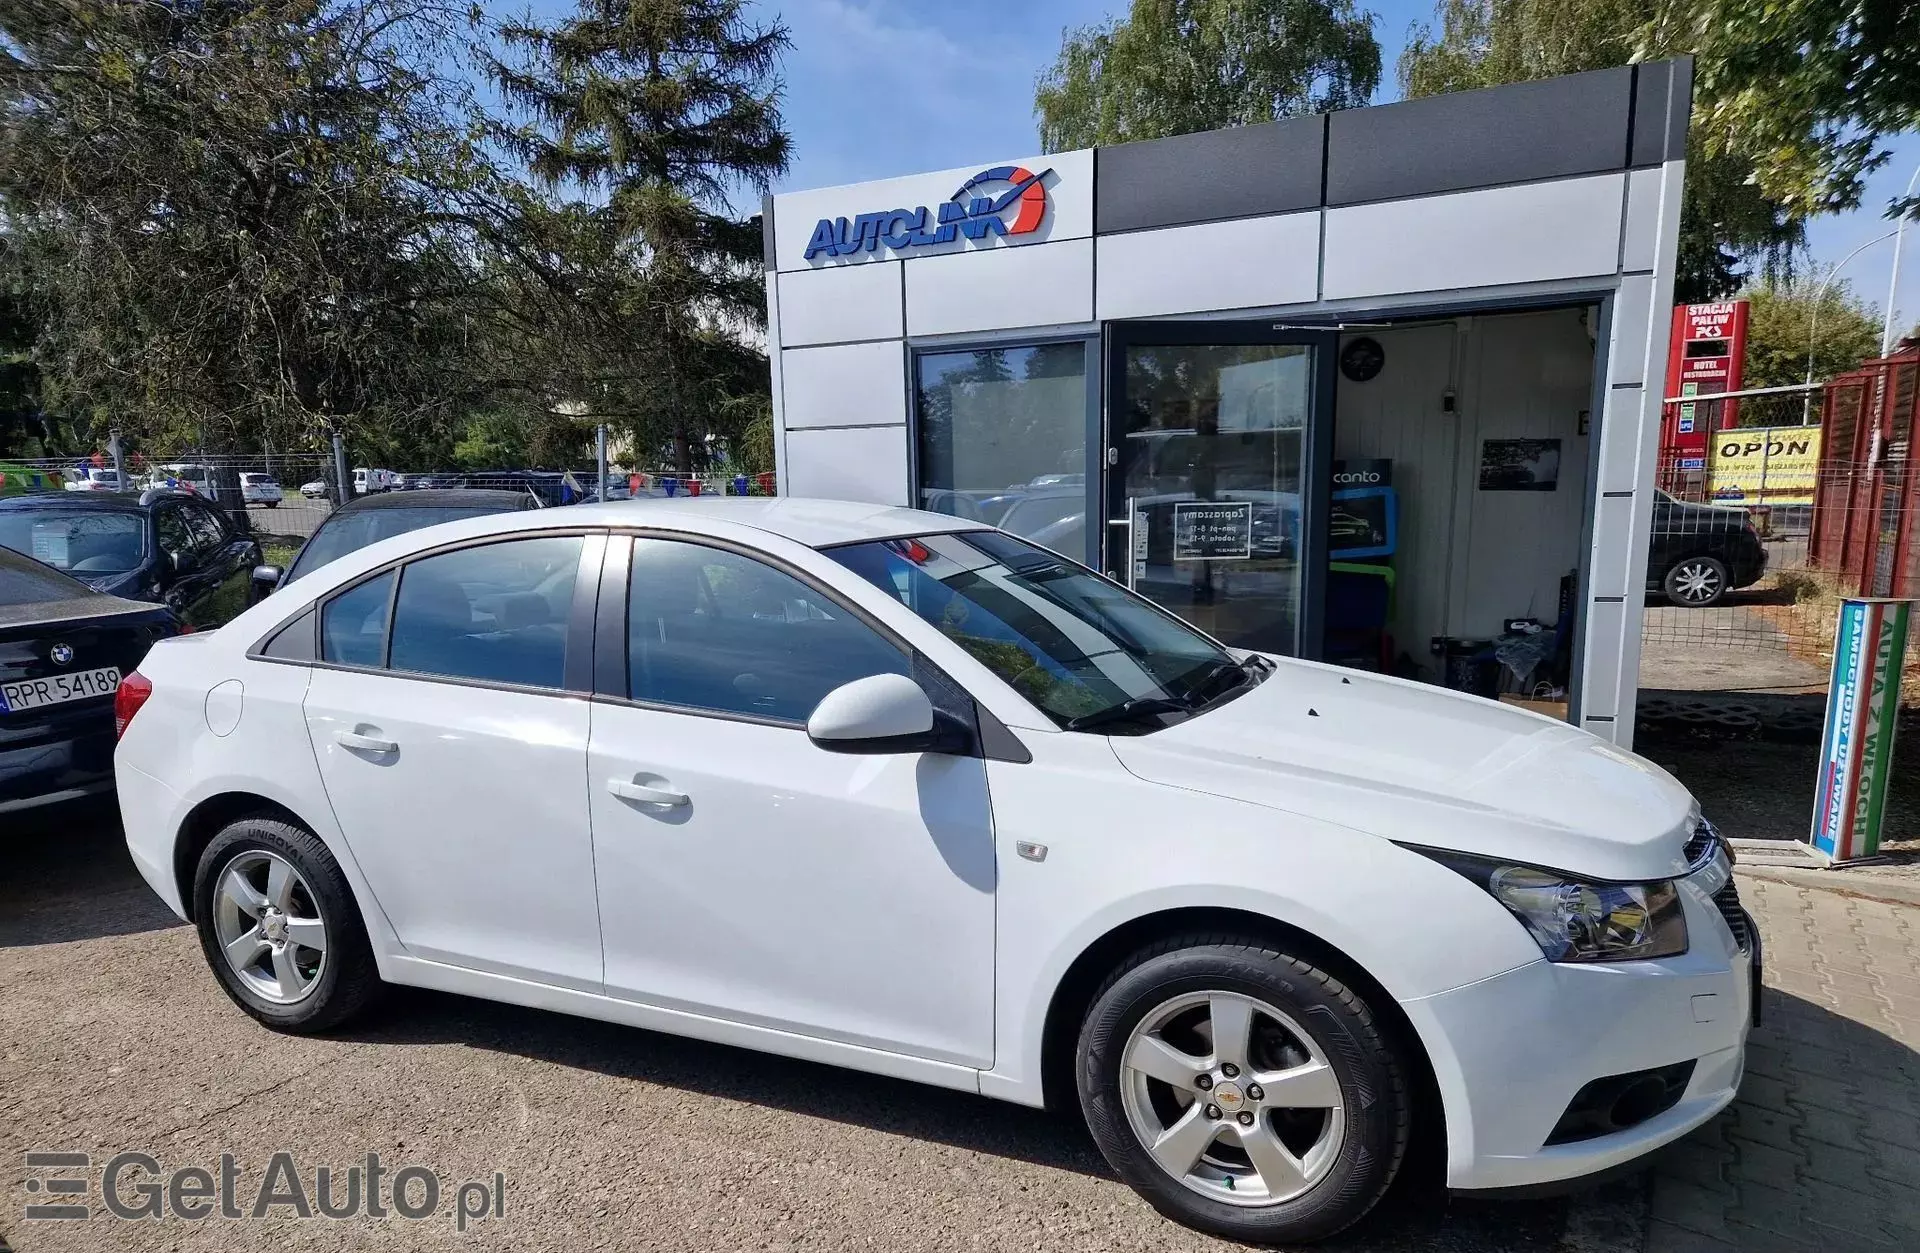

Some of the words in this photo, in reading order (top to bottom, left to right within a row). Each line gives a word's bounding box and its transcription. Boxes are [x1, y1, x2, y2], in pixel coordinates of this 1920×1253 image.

[803, 196, 1010, 260] AUTOLINK
[1689, 303, 1734, 315] STACJA
[1691, 314, 1730, 325] PALIW
[1720, 441, 1809, 457] OPON
[1841, 609, 1863, 738] SAMOCHODY
[1871, 619, 1894, 697] AUTA
[5, 681, 53, 708] RPR
[56, 669, 119, 699] 54189
[1867, 706, 1881, 724] Z
[1853, 732, 1878, 836] WŁOCH
[247, 828, 305, 866] UNIROYAL
